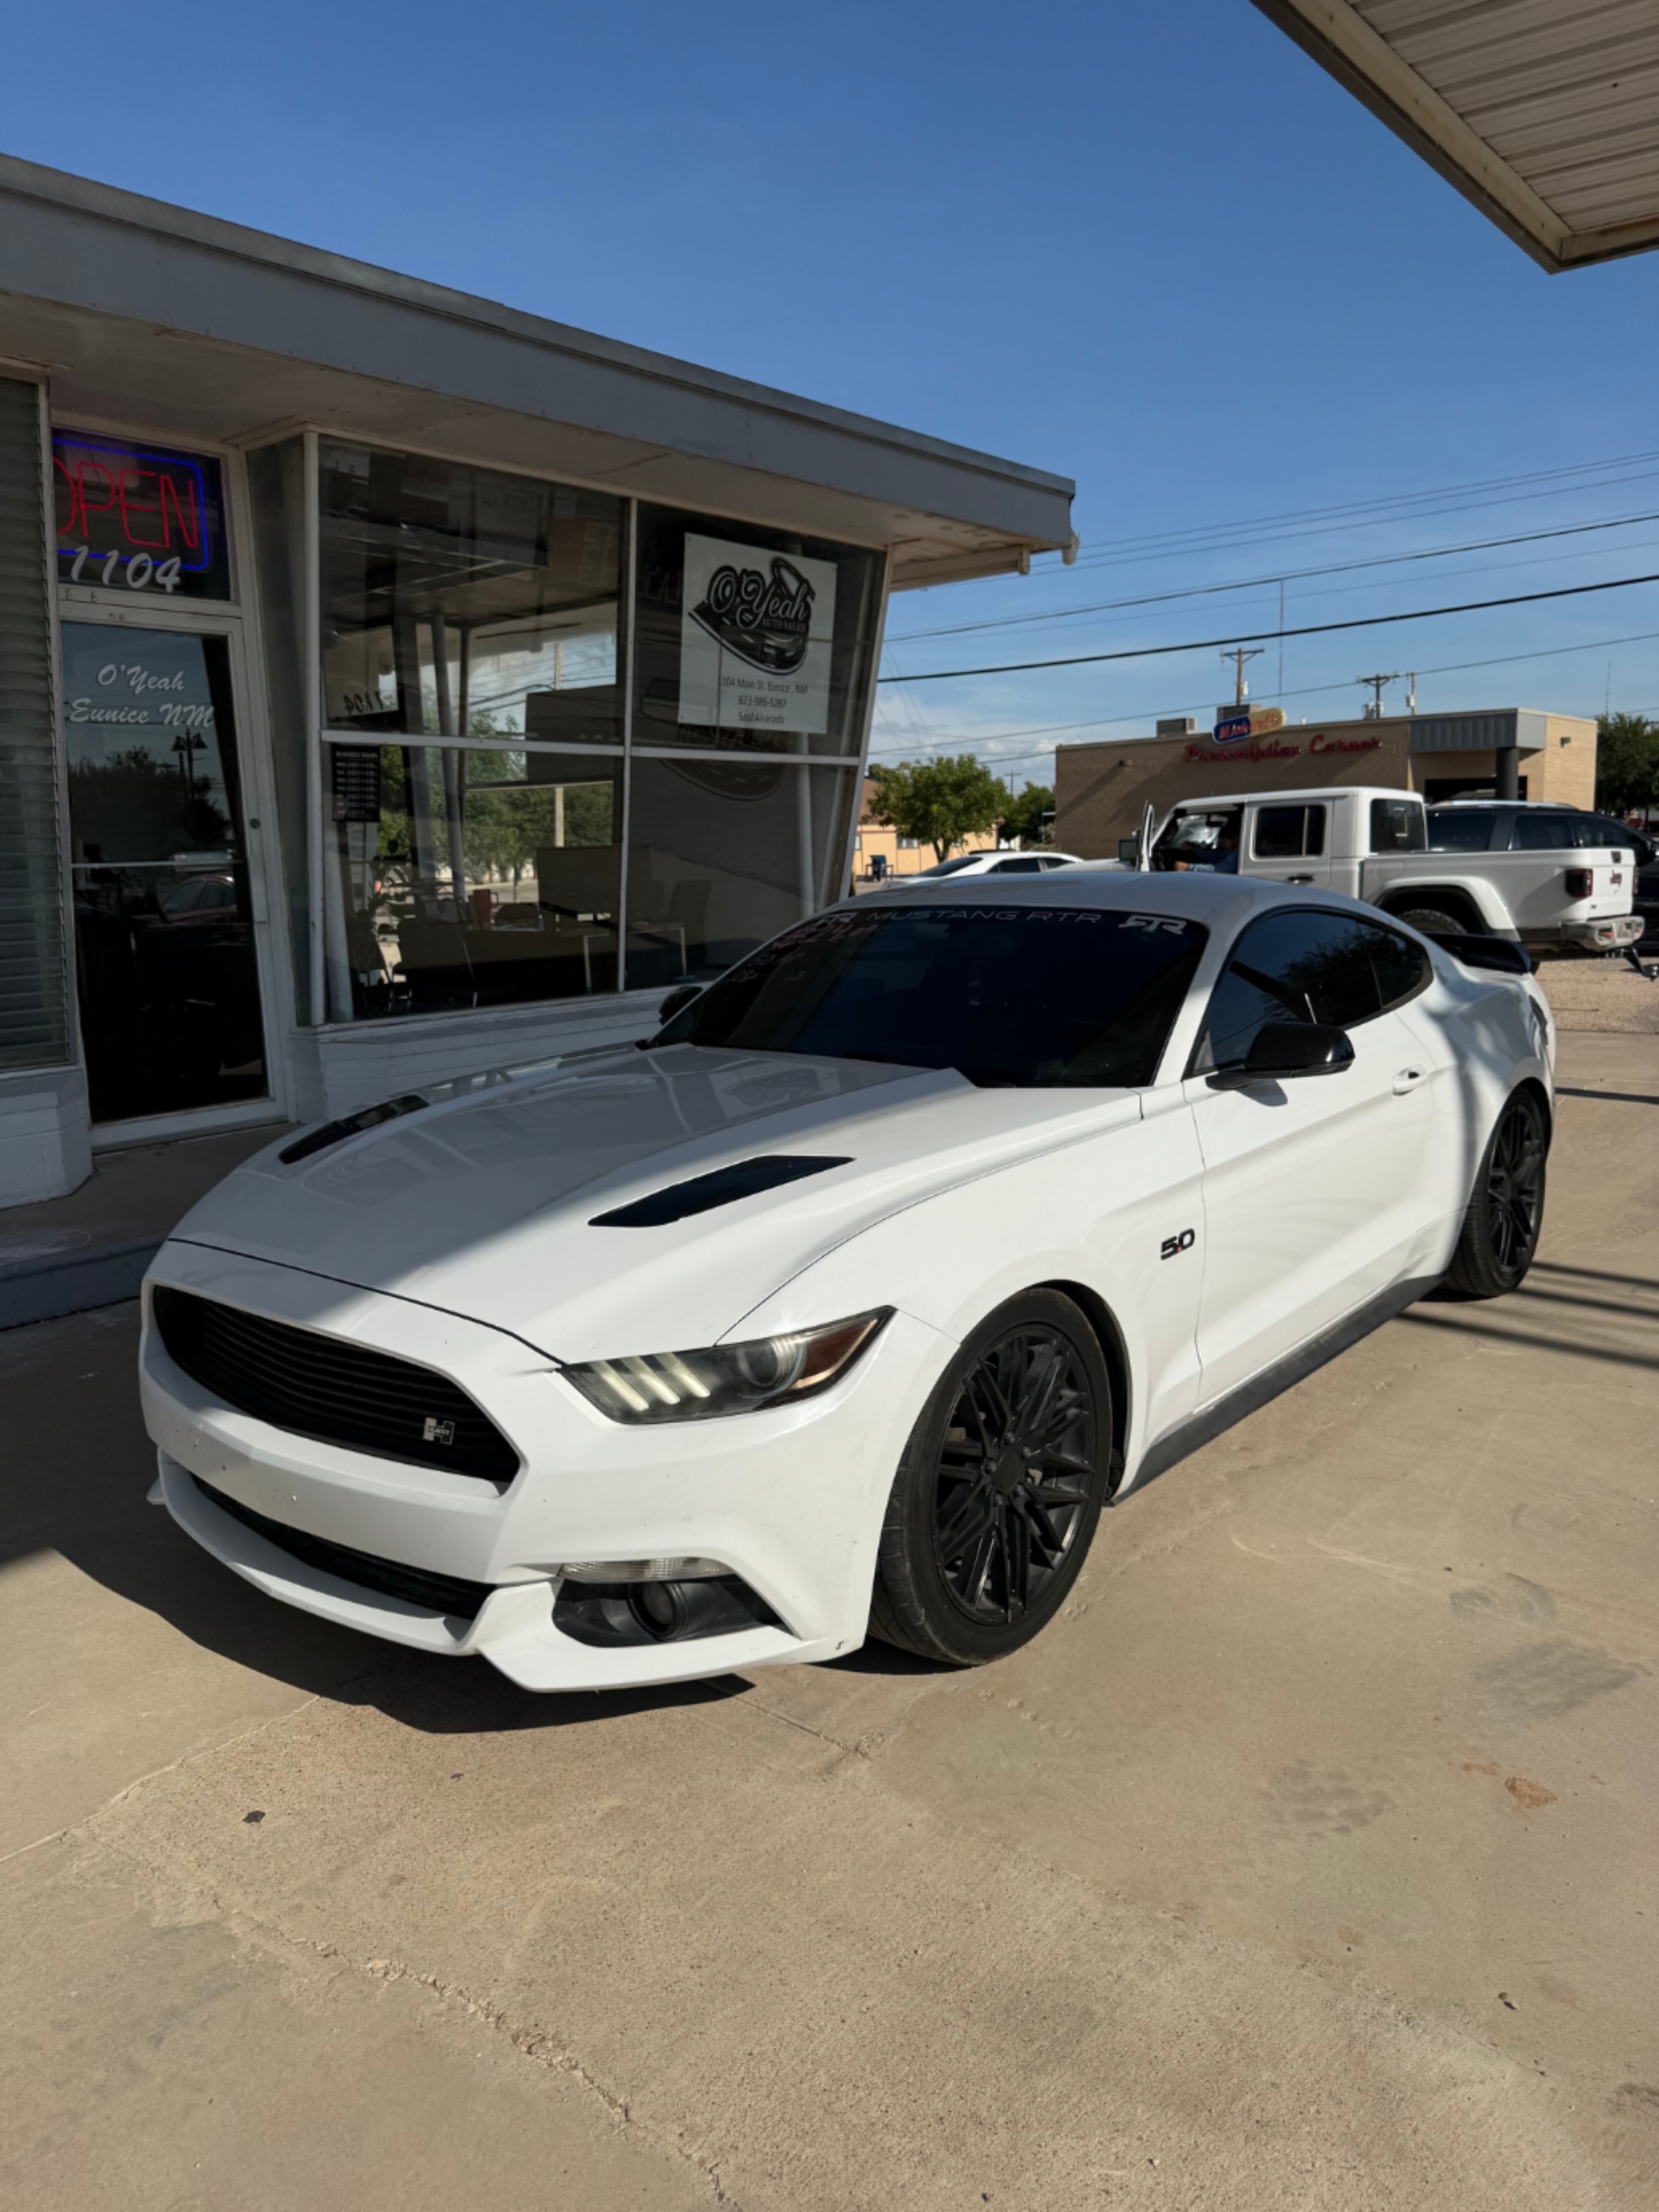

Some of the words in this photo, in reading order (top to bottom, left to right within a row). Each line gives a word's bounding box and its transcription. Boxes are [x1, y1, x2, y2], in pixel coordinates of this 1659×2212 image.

[71, 545, 182, 593] 1104
[97, 664, 185, 695] O'Yeah
[737, 678, 755, 688] Main
[70, 698, 149, 723] Eunice
[159, 703, 215, 728] NM
[866, 910, 1018, 922] MUSTANG
[1027, 911, 1103, 923] RTR
